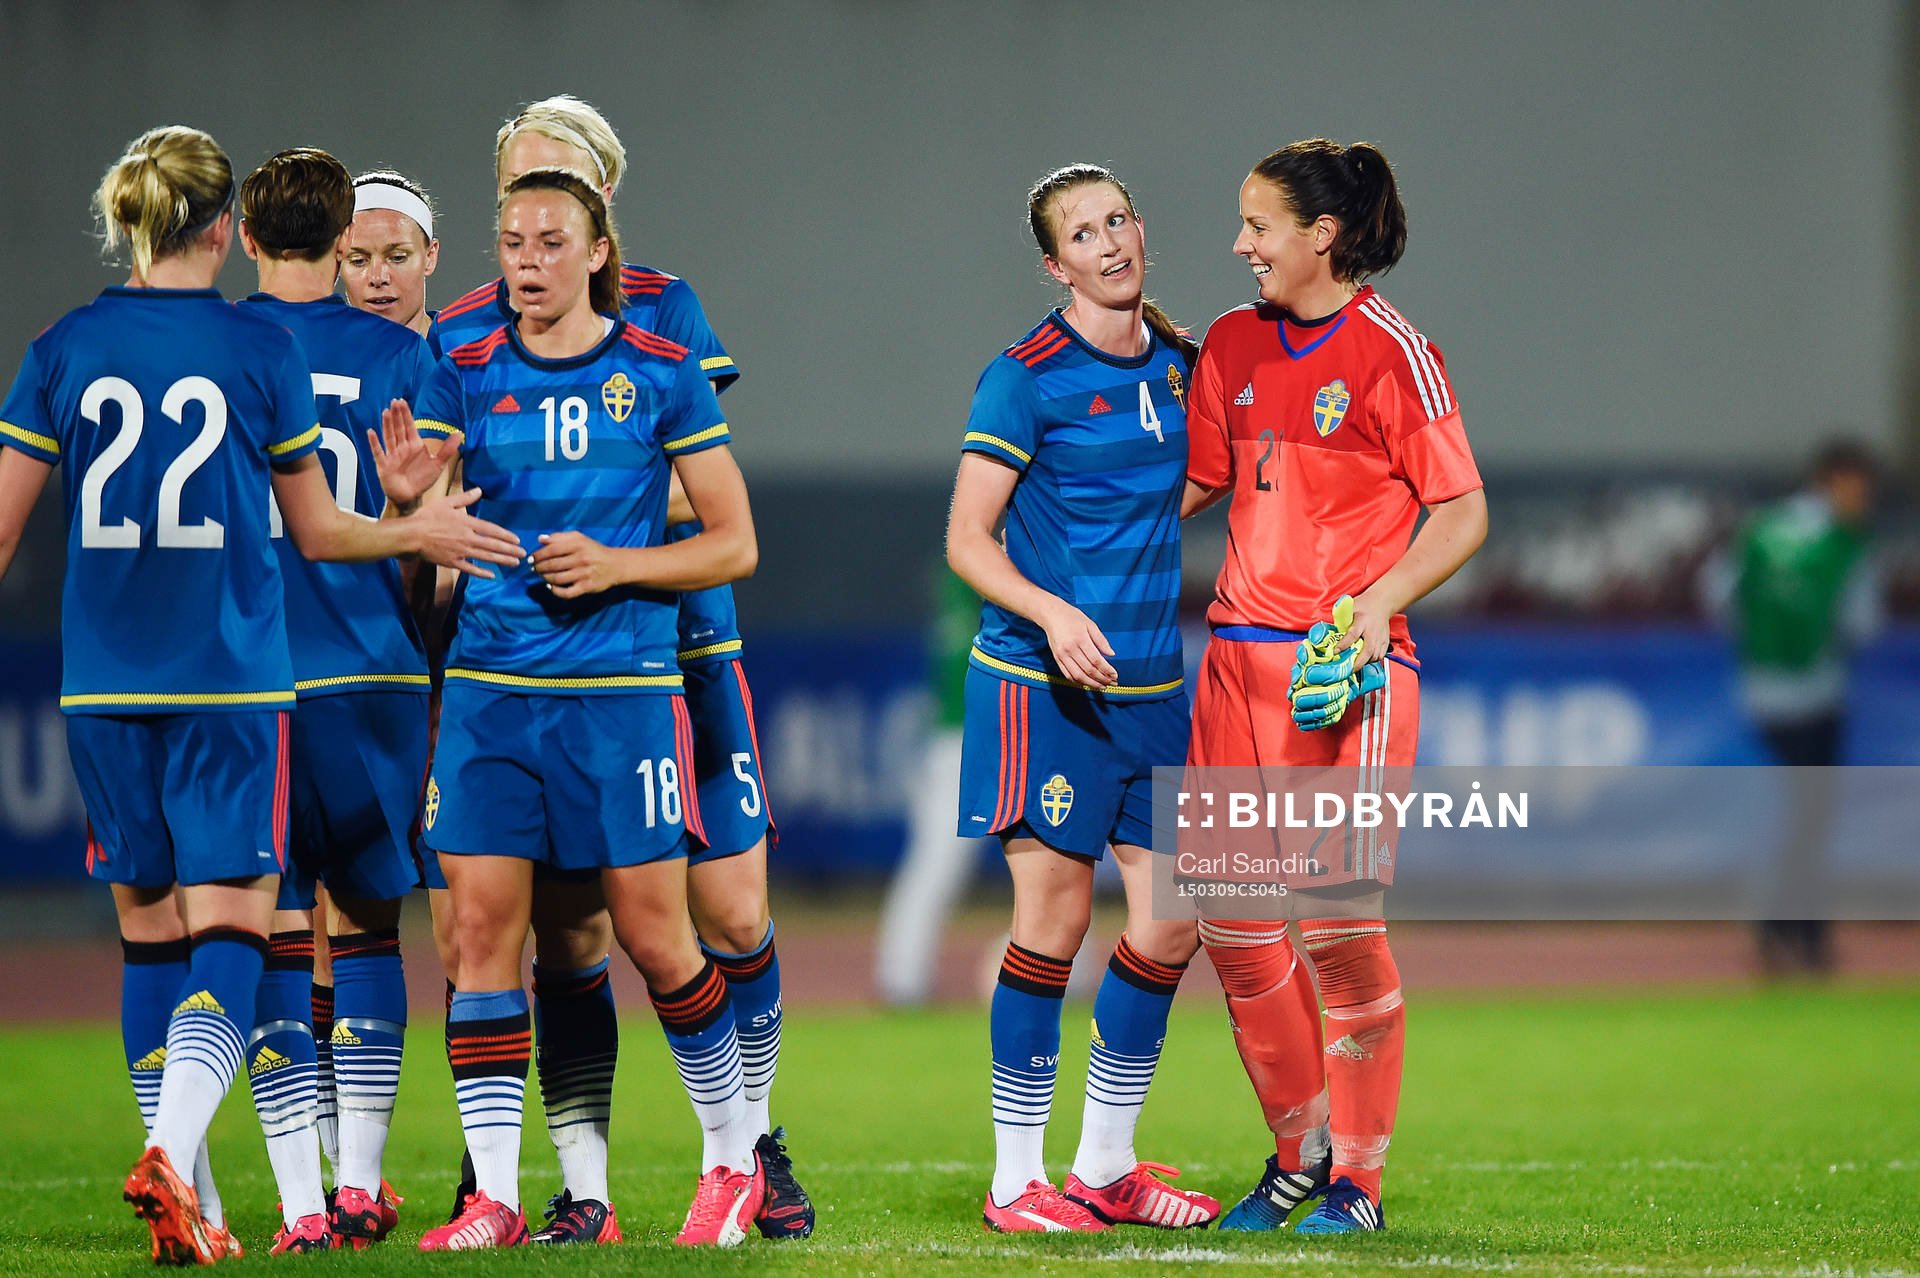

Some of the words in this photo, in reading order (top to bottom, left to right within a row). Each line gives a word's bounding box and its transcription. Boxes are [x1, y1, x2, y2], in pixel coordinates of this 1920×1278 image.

[538, 396, 589, 462] 18
[1138, 380, 1165, 443] 4
[80, 375, 228, 549] 22
[635, 757, 683, 829] 18
[731, 752, 761, 818] 5
[250, 1057, 291, 1076] adidas
[1030, 1053, 1060, 1068] SV
